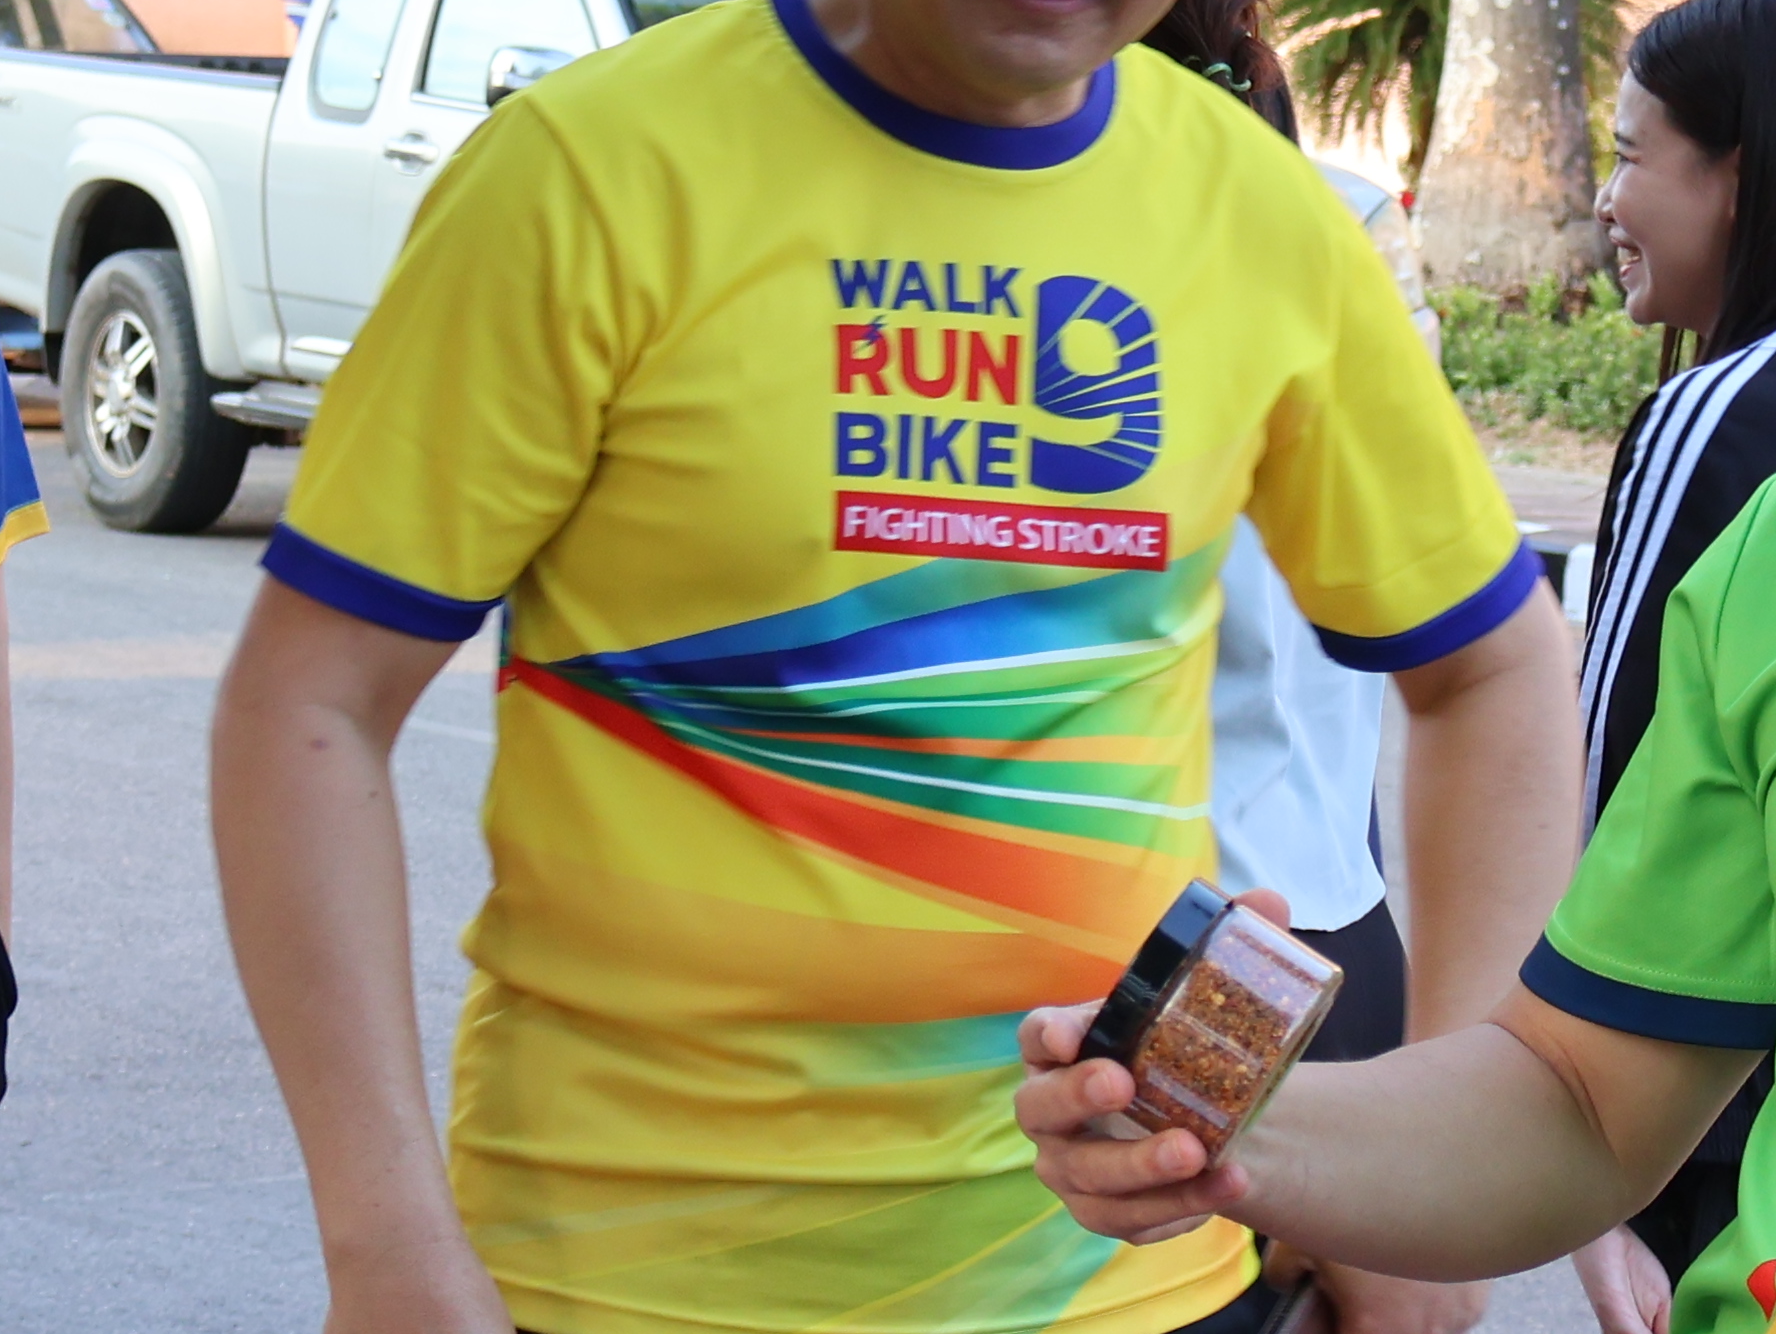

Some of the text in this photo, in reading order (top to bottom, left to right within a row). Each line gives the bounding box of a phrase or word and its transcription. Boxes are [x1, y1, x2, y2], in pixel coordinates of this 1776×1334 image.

[831, 258, 1023, 318] WALK
[834, 322, 1021, 405] RUN
[834, 411, 1021, 489] BIKE
[843, 505, 1161, 558] FIGHTING STROKE
